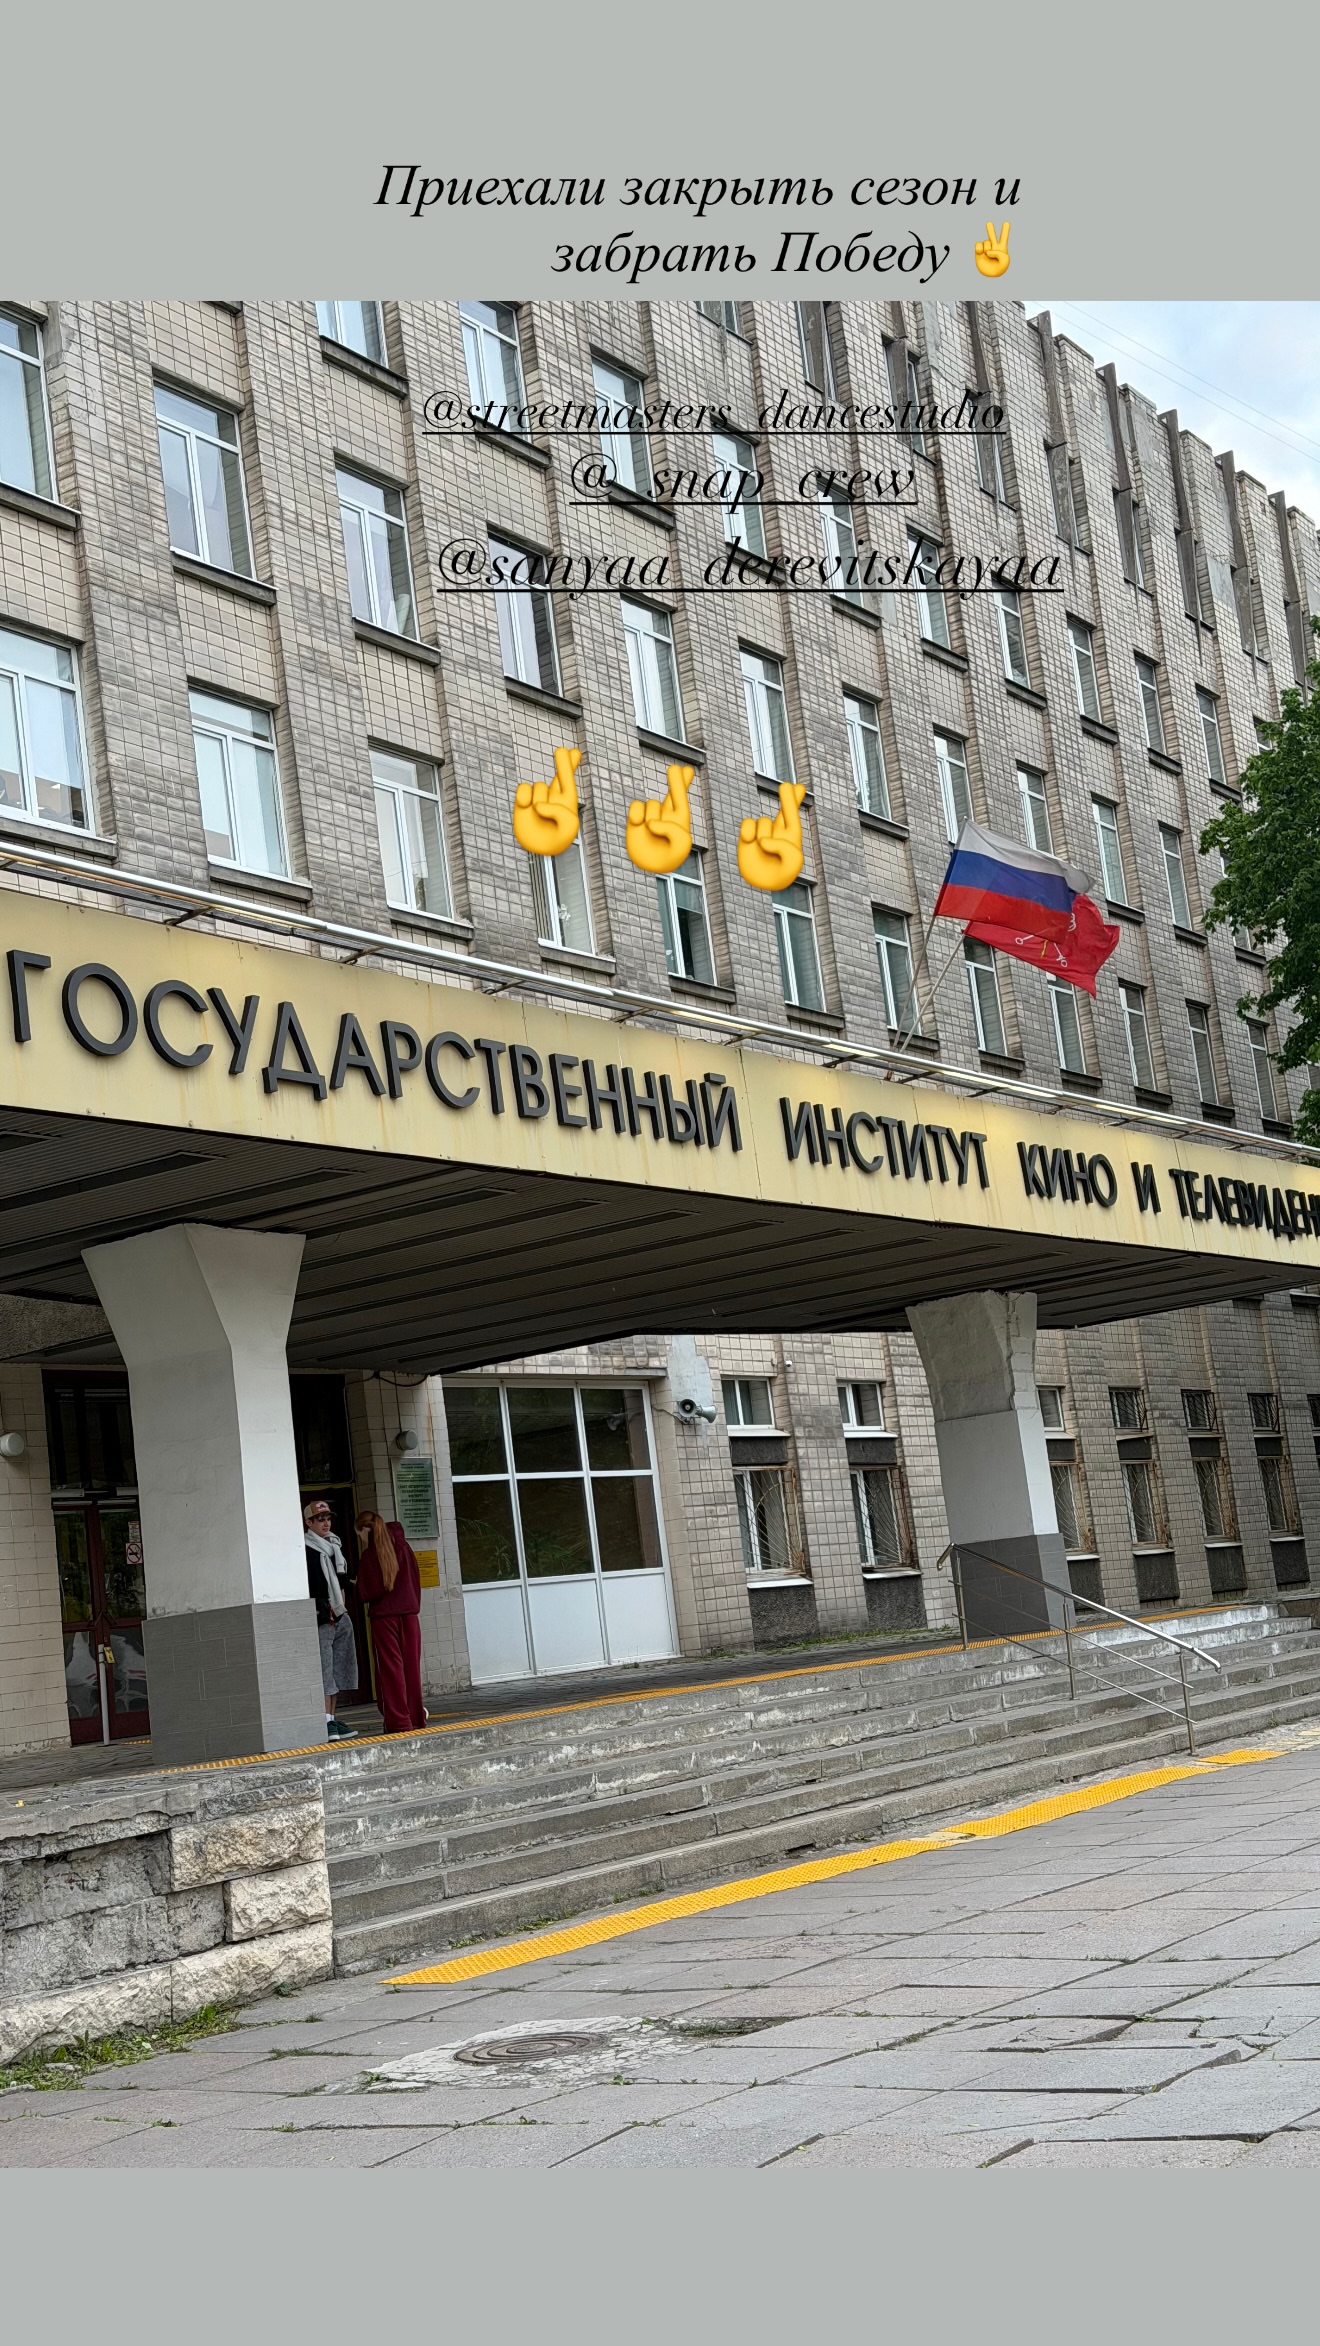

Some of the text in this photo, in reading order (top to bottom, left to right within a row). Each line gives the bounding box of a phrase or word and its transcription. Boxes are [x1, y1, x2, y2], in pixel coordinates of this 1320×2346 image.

[6, 949, 743, 1152] ГОСУДАРСТВЕННЫЙ
[778, 1096, 991, 1190] ИНСТИТУТ
[1017, 1141, 1118, 1208] КИНО
[1131, 1161, 1162, 1213] И
